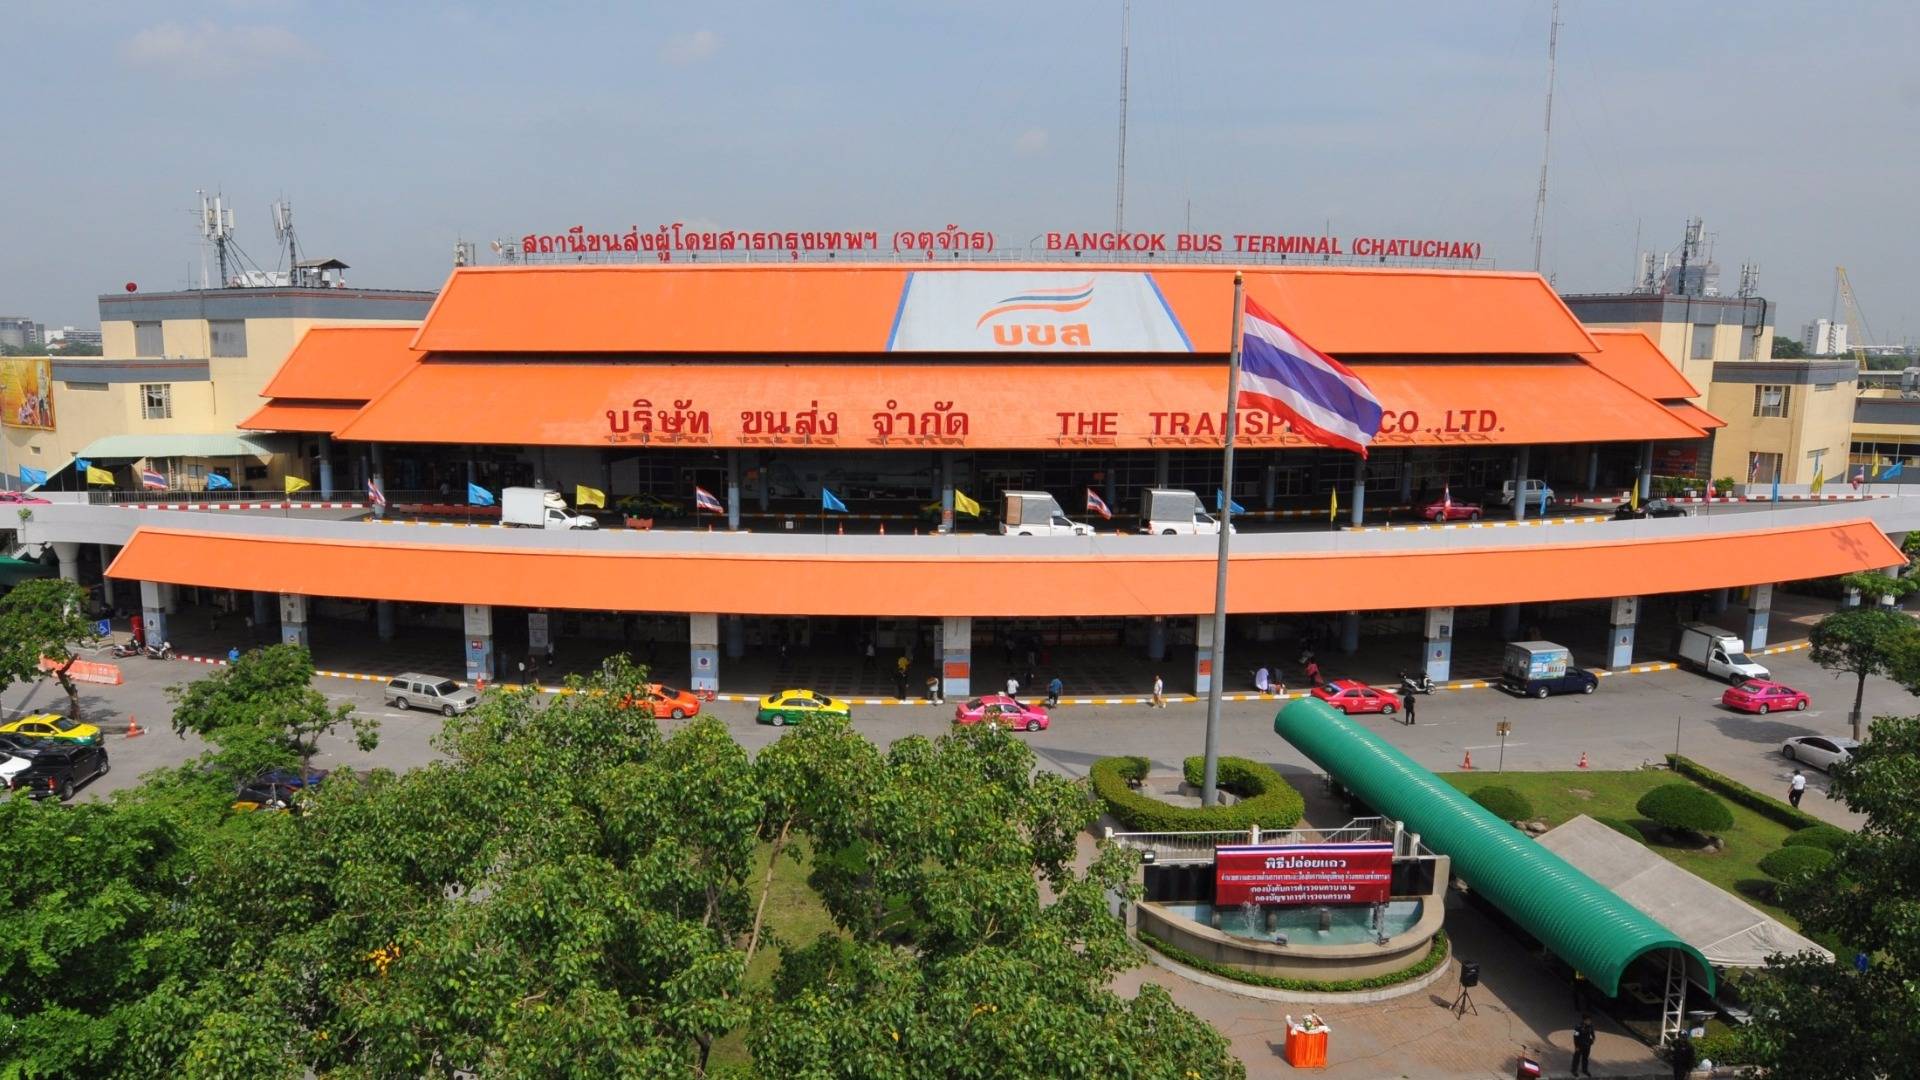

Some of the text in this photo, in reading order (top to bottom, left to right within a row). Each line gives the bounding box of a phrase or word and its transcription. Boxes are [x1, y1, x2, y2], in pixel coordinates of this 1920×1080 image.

[522, 223, 994, 261] สถานีขนส่งผู้โดยสารกรุงเทพฯ (จตุจักร)
[1047, 233, 1481, 259] BANGKOK BUS TERMINAL (CHATUCHAK)
[993, 322, 1092, 346] บขส
[606, 399, 969, 435] บริษัท ขนส่ง จำกัด
[1057, 410, 1505, 435] THE TRANSP CO.,LTD.
